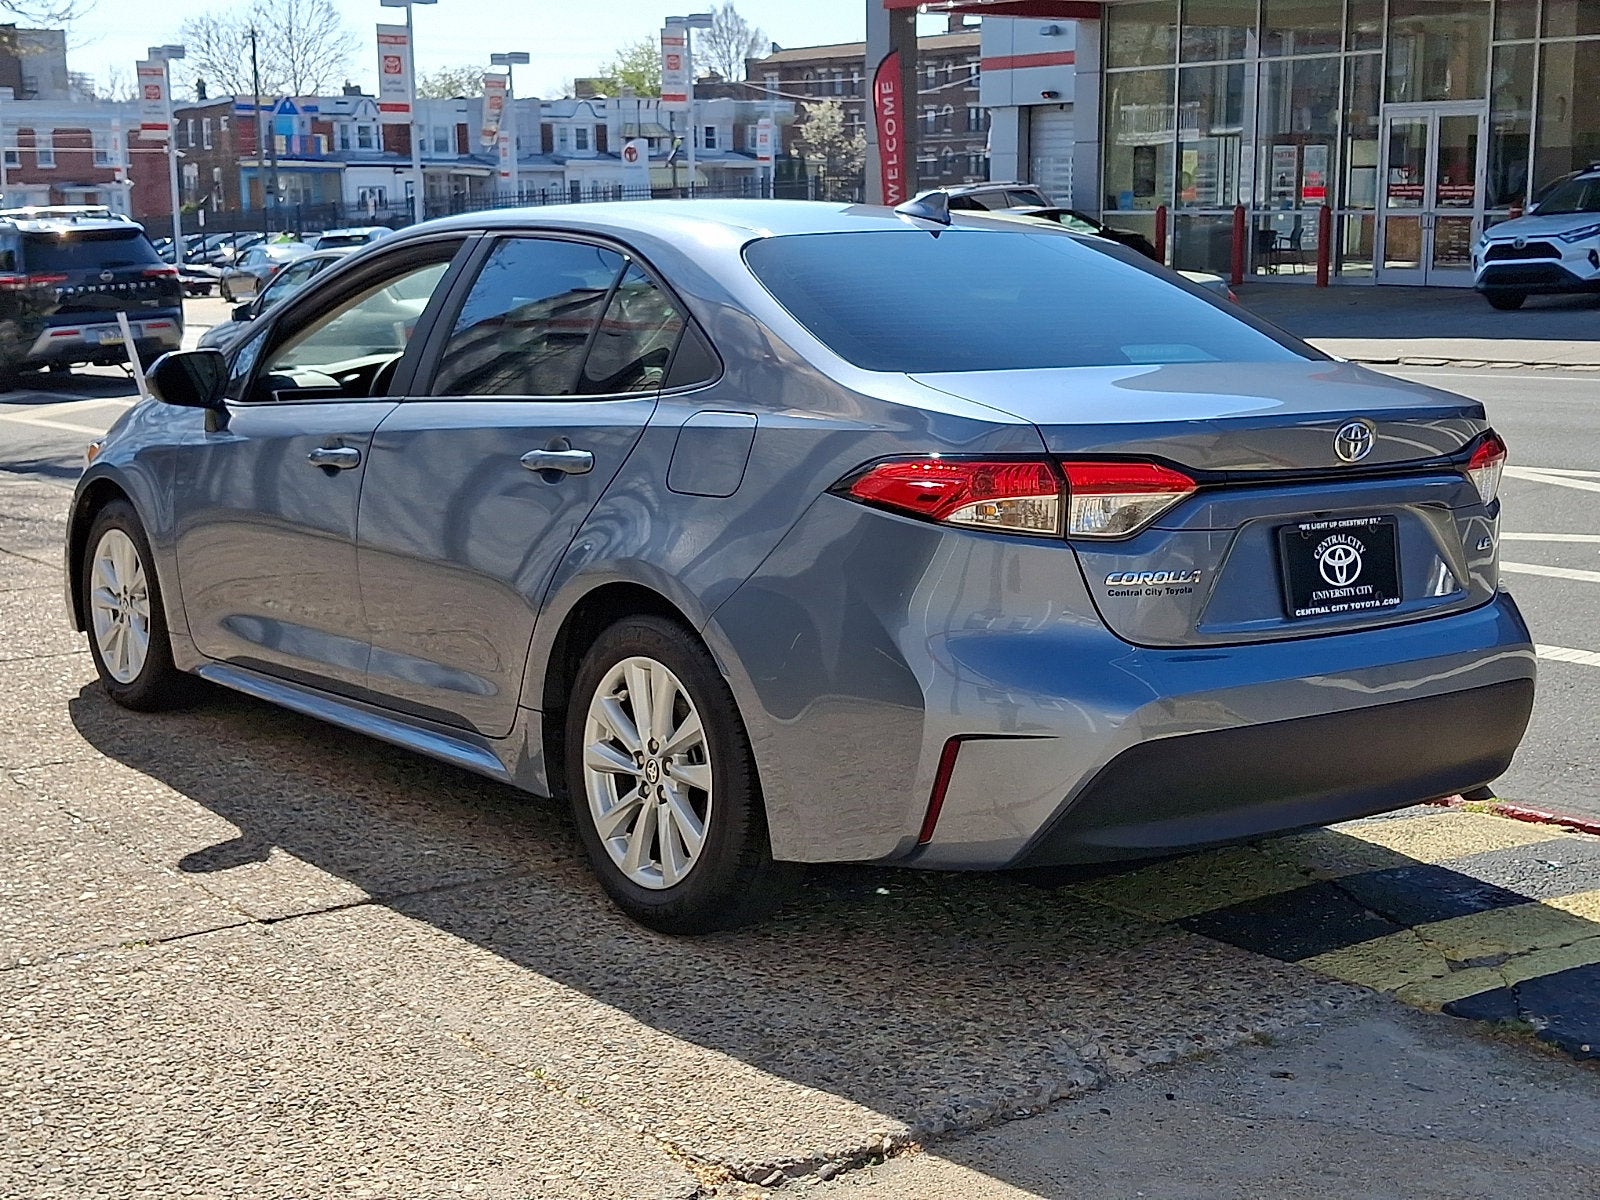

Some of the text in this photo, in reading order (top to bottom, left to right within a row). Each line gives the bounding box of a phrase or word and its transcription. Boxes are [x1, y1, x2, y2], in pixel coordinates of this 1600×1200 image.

[882, 80, 900, 203] WELCOME
[55, 281, 156, 294] PATHFINDER
[1311, 522, 1328, 530] LIGHT
[1338, 519, 1368, 527] CHESTNUT
[1314, 534, 1366, 559] CENTRAL CITY
[1105, 569, 1202, 586] COROLLA
[1107, 586, 1193, 597] Central City Toyota
[1312, 585, 1373, 600] UNIVERSITY CITY
[1295, 606, 1330, 617] CENTRAL
[1331, 603, 1348, 612] CITY
[1350, 600, 1380, 610] TOYOTA
